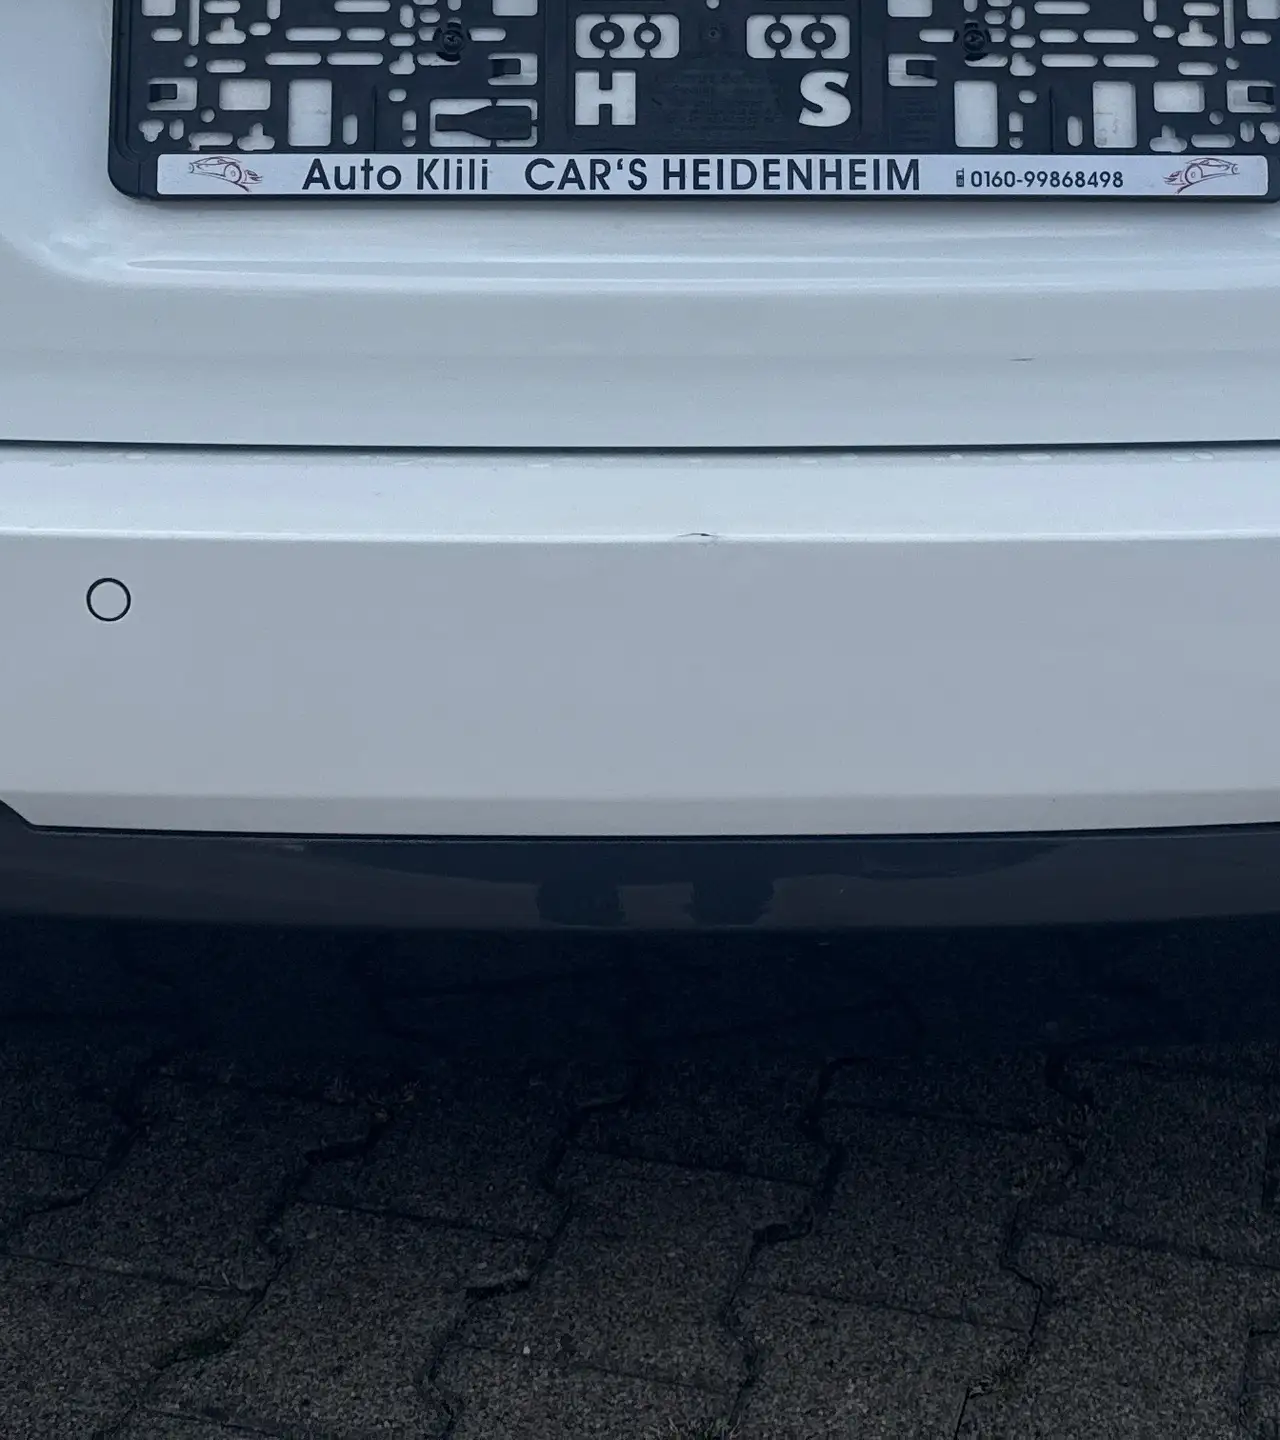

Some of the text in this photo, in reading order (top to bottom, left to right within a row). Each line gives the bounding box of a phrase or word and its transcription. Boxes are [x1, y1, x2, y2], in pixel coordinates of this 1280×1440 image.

[302, 158, 402, 191] Auto
[417, 158, 489, 191] Klili
[662, 158, 920, 191] HEIDENHEIM
[969, 169, 1124, 189] 0160-99868498
